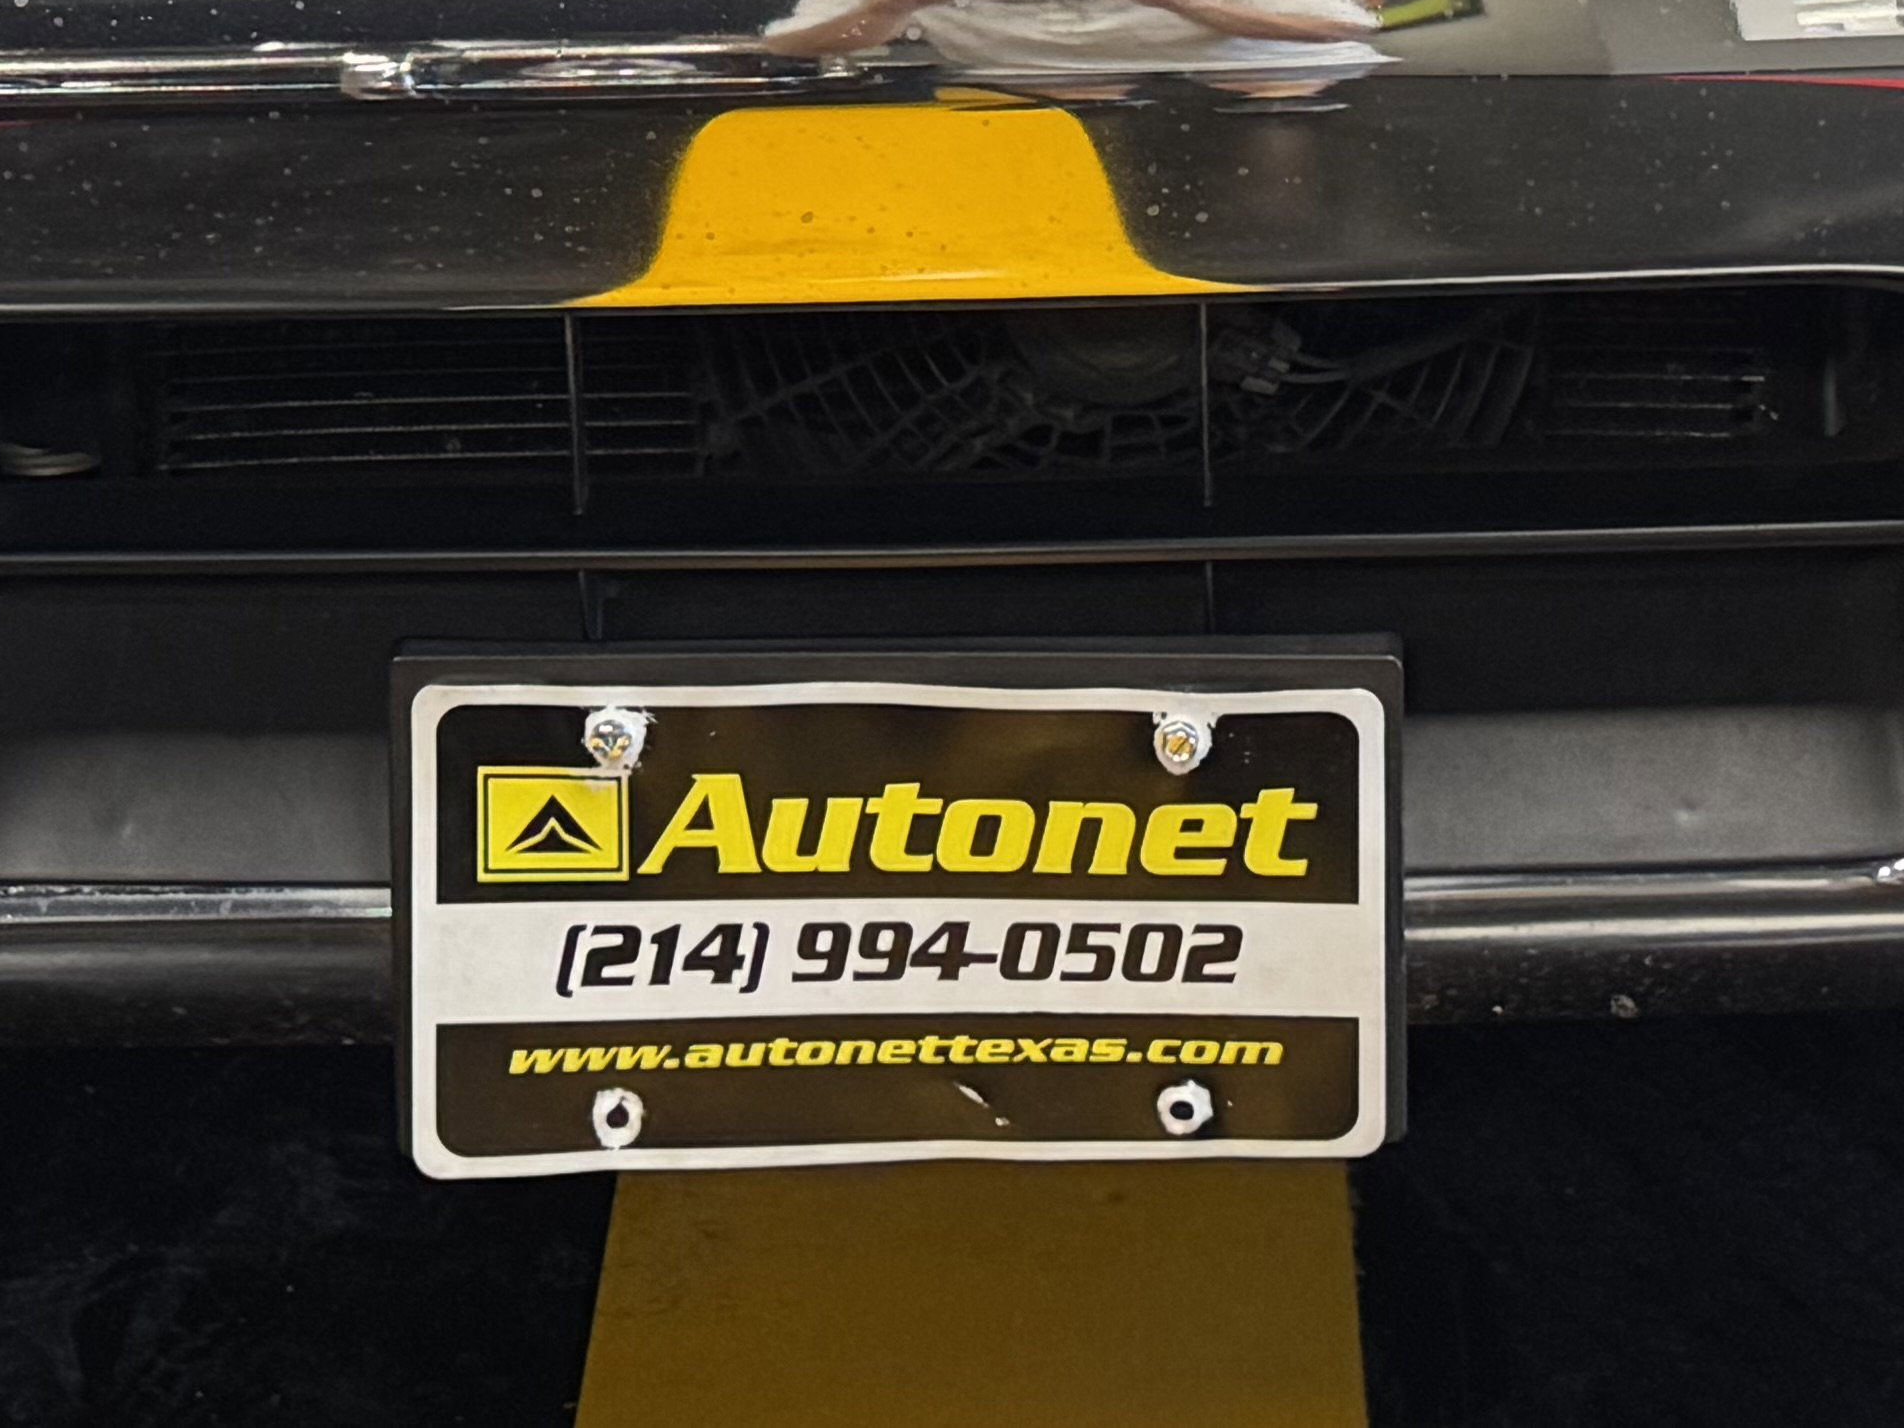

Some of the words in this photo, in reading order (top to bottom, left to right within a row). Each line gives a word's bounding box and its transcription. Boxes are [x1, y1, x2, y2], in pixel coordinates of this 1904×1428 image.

[637, 772, 1318, 877] Autonet
[555, 922, 771, 997] (214)
[791, 921, 1243, 985] 994-0502
[507, 1033, 1284, 1075] www.autonettexas.com
